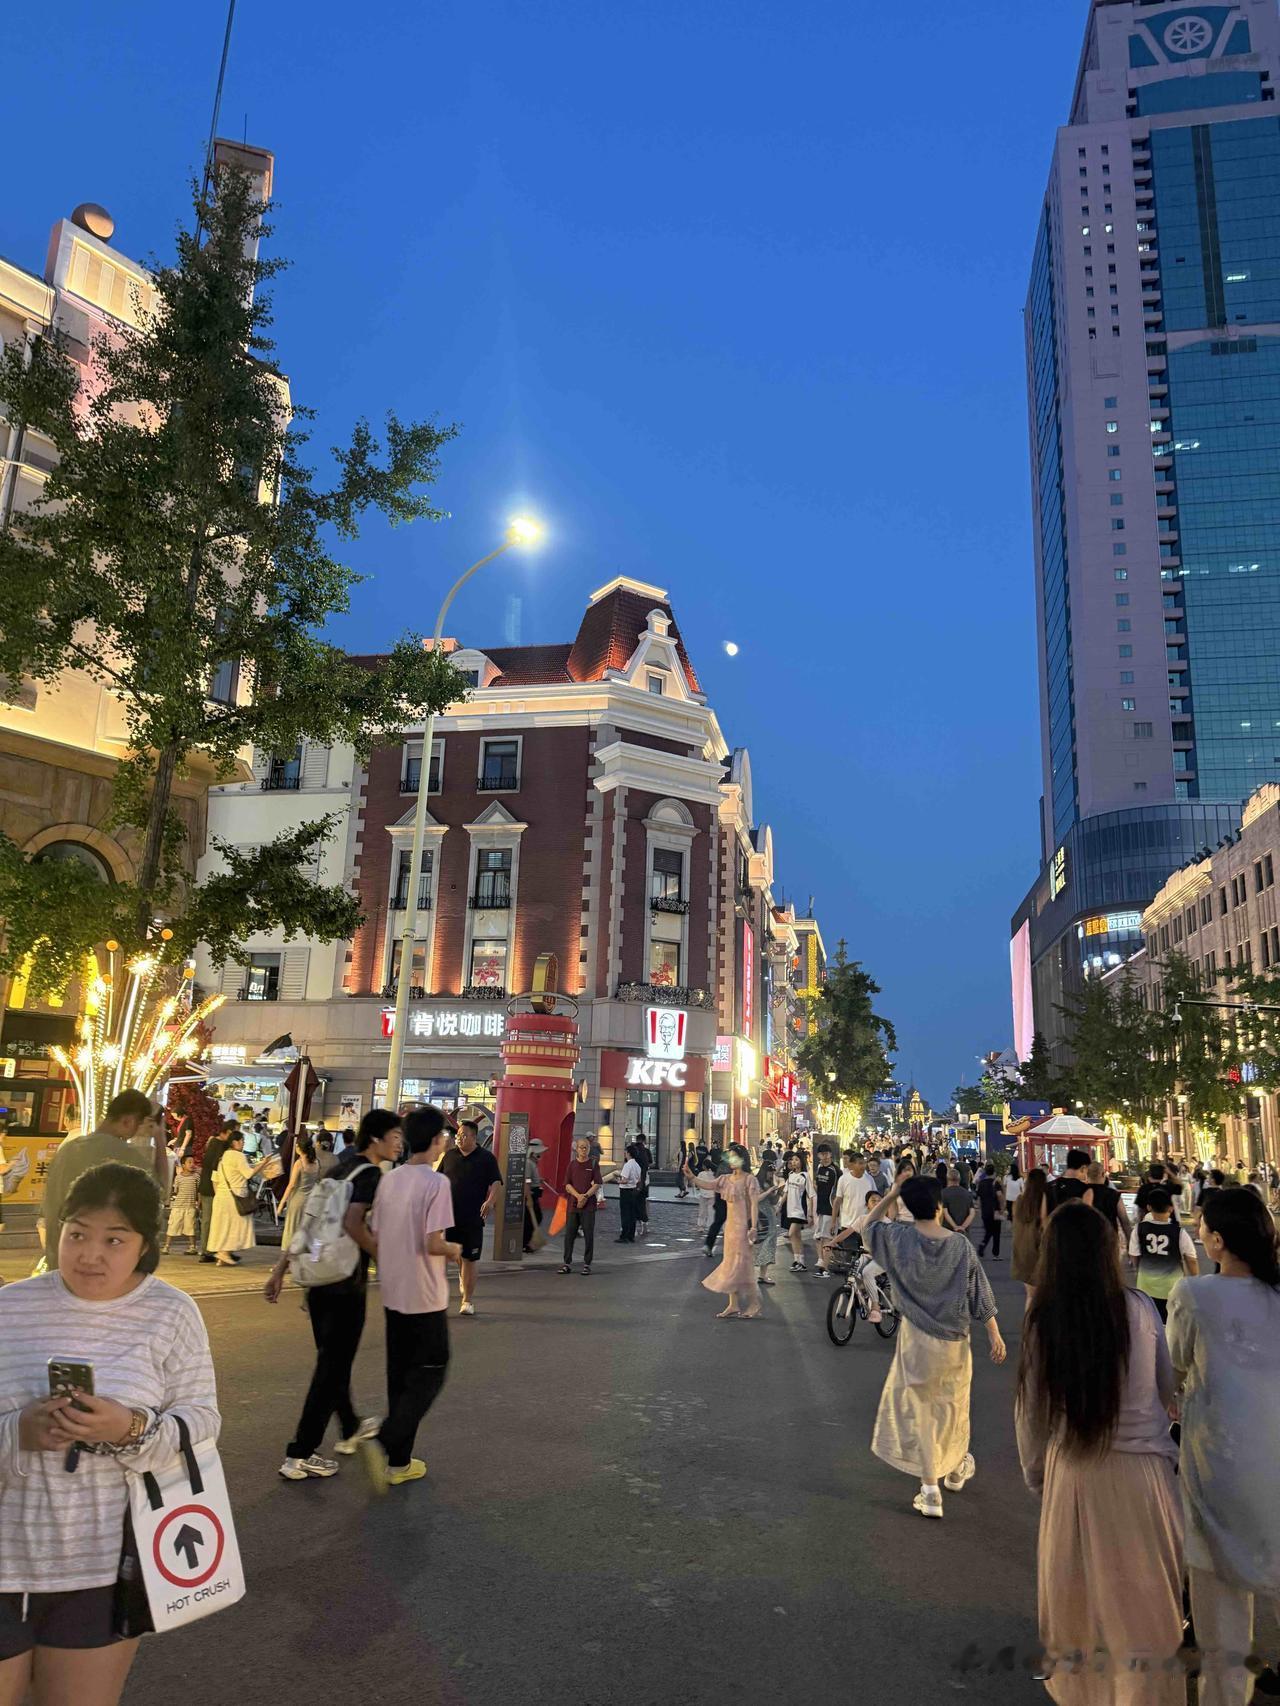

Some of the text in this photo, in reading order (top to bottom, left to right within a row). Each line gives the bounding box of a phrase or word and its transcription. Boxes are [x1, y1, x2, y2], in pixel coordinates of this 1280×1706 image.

[412, 1012, 505, 1037] 肯悦咖啡
[627, 1059, 688, 1088] KFC
[1145, 1233, 1170, 1256] 32
[166, 1578, 231, 1614] HOT CRUSH
